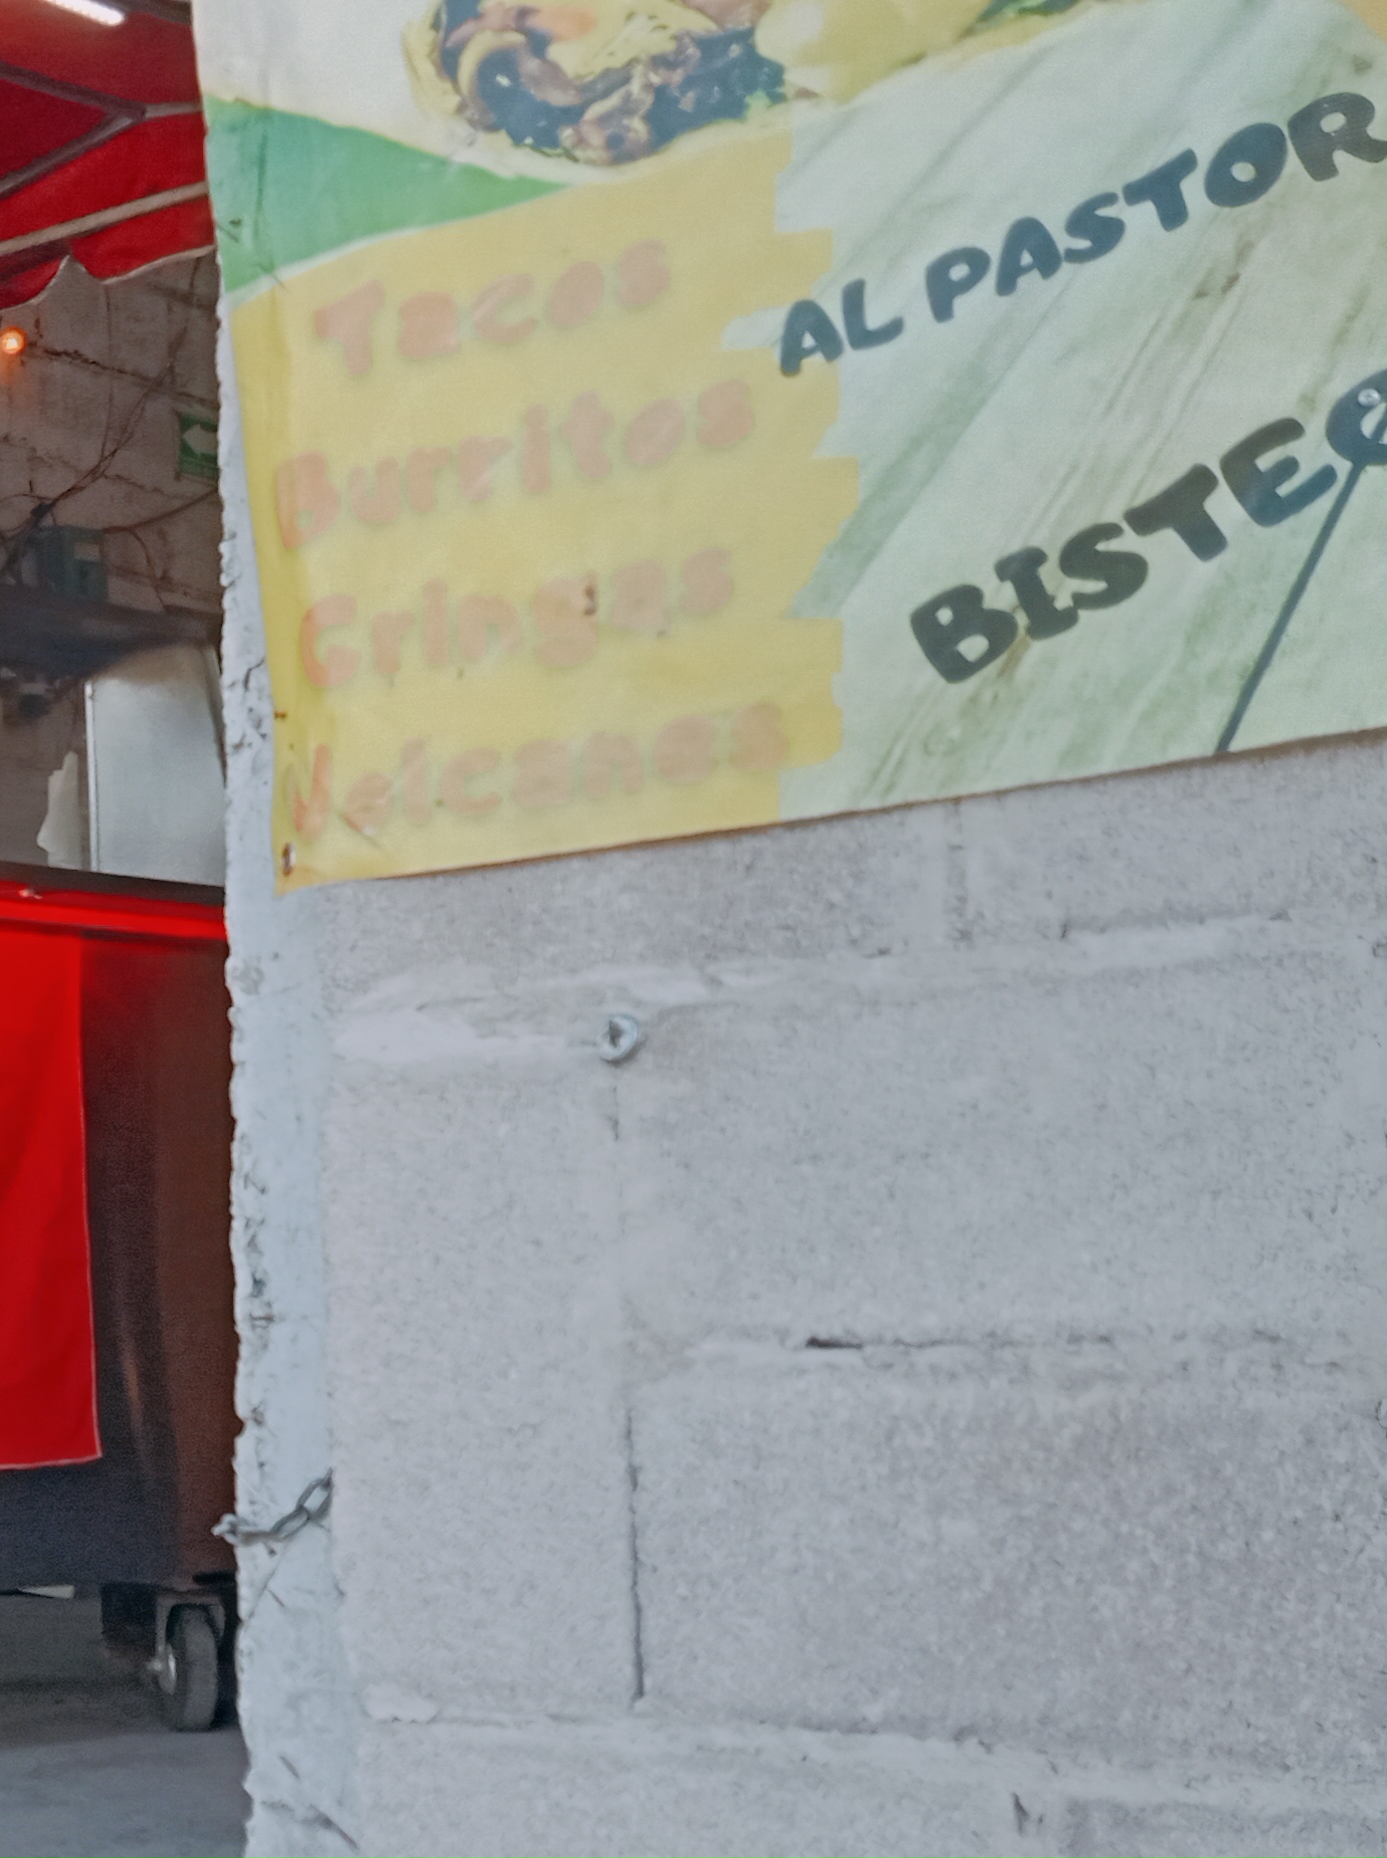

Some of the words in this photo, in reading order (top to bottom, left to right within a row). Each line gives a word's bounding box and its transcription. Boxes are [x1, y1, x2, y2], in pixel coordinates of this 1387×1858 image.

[313, 239, 671, 377] Tacos
[779, 278, 904, 377] AL
[926, 92, 1387, 323] PASTOR
[274, 378, 756, 551] Burritos
[301, 546, 735, 688] Gringas
